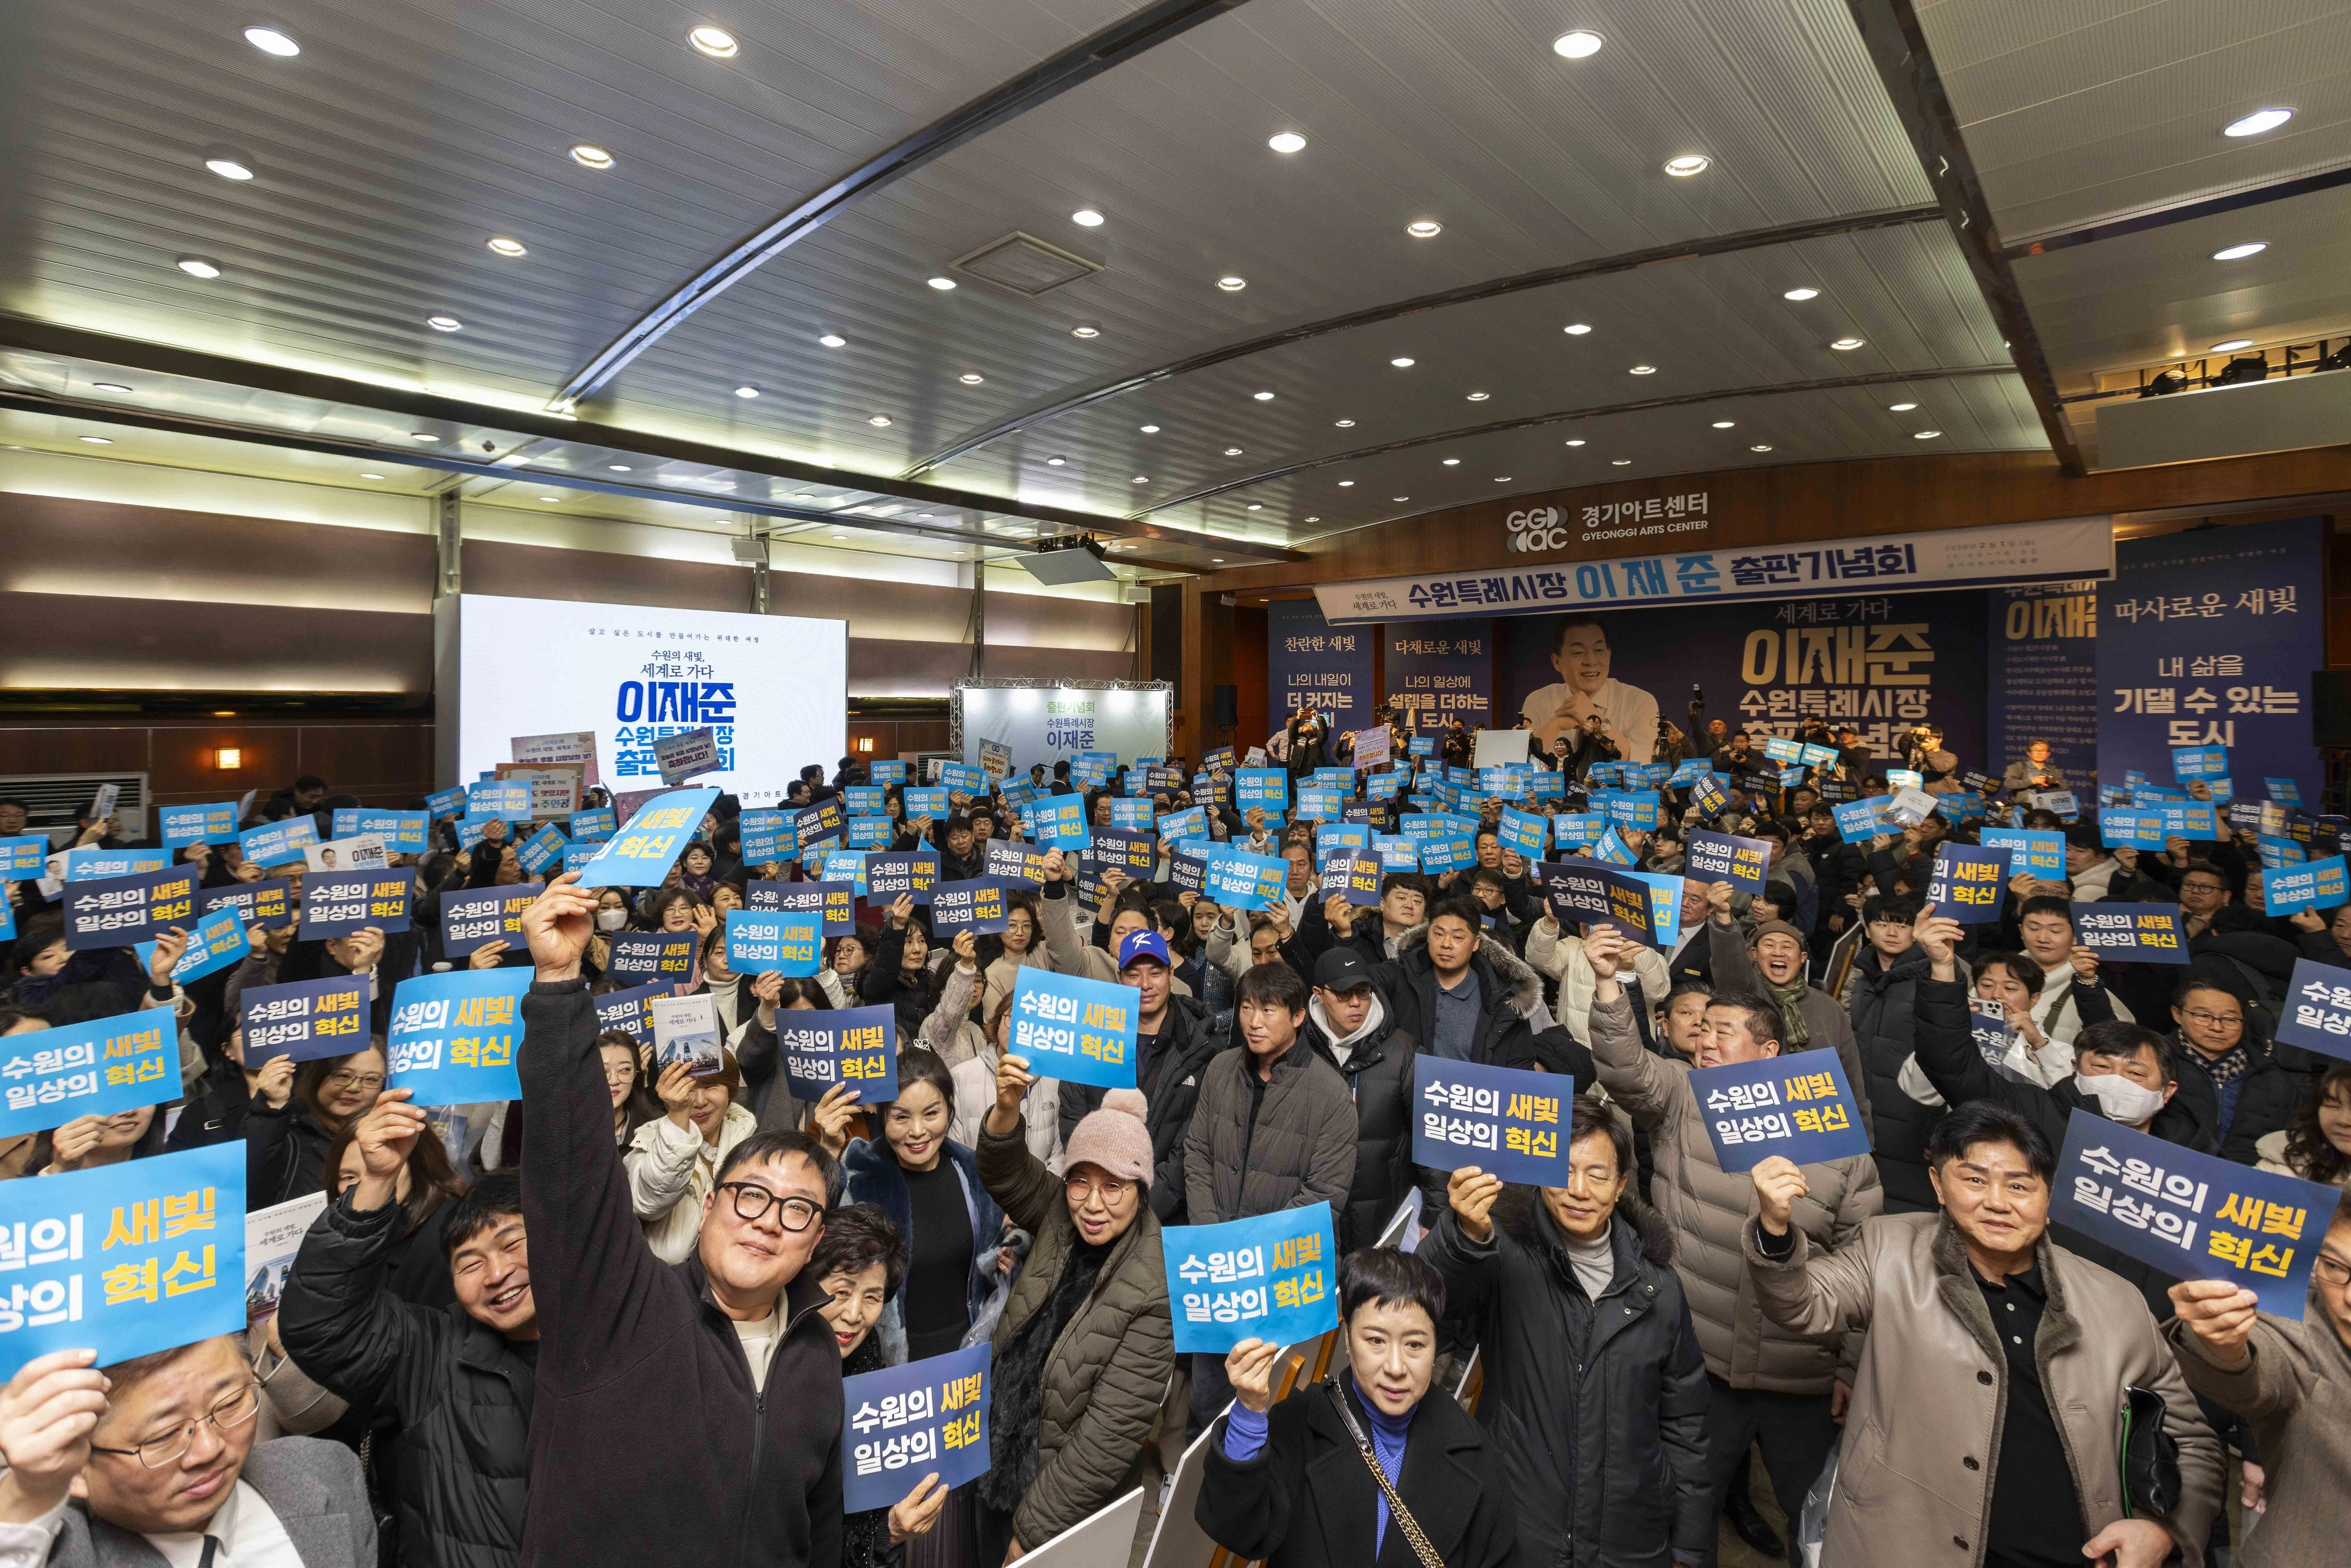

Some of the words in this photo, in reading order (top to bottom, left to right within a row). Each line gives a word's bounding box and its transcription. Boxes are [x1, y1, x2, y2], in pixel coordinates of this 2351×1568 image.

[1582, 492, 1707, 528] 경기아트센터
[1582, 529, 1637, 541] GYEONGGI
[1639, 525, 1665, 535] ARTS
[1667, 521, 1708, 532] CENTER
[1409, 572, 1567, 609] 수원특례시장
[1576, 555, 1722, 599] 이재준
[1731, 544, 1917, 586] 출판기념회
[1353, 601, 1379, 611] 세계로
[1379, 599, 1397, 609] 가다
[1374, 591, 1389, 599] 새빛,
[2116, 592, 2228, 624] 따사로운
[2234, 585, 2299, 615] 새빛
[1774, 601, 1842, 624] 세계로
[1848, 598, 1894, 621] 가다
[669, 632, 709, 641] 만들어가는
[1284, 636, 1325, 652] 찬란한
[1327, 635, 1356, 652] 새빛
[1395, 640, 1450, 655] 다채로운
[1454, 639, 1481, 655] 새빛
[651, 651, 680, 662] 수원의
[684, 651, 705, 662] 새빛,
[1741, 623, 1935, 685] 이재준
[2158, 658, 2184, 677] 내
[2189, 655, 2244, 677] 삶을
[641, 663, 684, 678] 세계로
[686, 664, 714, 679] 가다
[1288, 674, 1311, 686] 나의
[1315, 674, 1351, 686] 내일이
[1405, 676, 1430, 688] 나의
[1434, 676, 1471, 688] 일상에
[617, 681, 736, 723] 이재준
[1046, 701, 1095, 713] 출판기념회
[1287, 692, 1302, 709] 더
[1306, 692, 1353, 709] 커지는
[1388, 694, 1436, 709] 설렘을
[1440, 693, 1488, 709] 더하는
[1740, 689, 1932, 718] 수원특례시장
[2114, 687, 2176, 715] 기댈
[2183, 688, 2218, 713] 수
[2228, 686, 2299, 713] 있는
[1047, 718, 1095, 728] 수원특례시장
[2167, 721, 2235, 747] 도시
[1047, 730, 1095, 749] 이재준
[615, 747, 735, 776] 출판회
[668, 751, 709, 768] 축하합니다!
[540, 799, 570, 809] 주인공
[1036, 809, 1056, 823] 수원의
[1059, 806, 1079, 819] 새빛
[1038, 825, 1057, 839] 일상의
[1059, 822, 1082, 836] 혁신
[1325, 859, 1350, 873] 수원의
[1353, 860, 1377, 875] 새빛
[74, 888, 145, 911] 수원의
[151, 879, 190, 901] 새빛
[1322, 875, 1349, 888] 일상의
[1352, 877, 1376, 892] 혁신
[75, 909, 146, 932] 일상의
[152, 900, 190, 920] 혁신
[2079, 914, 2132, 929] 수원의
[2137, 916, 2173, 930] 새빛
[2082, 932, 2136, 946] 일상의
[2139, 933, 2178, 948] 혁신
[248, 997, 309, 1023] 수원의
[314, 991, 359, 1013] 새빛
[393, 1000, 450, 1036] 수원의
[454, 996, 514, 1026] 새빛
[1020, 990, 1078, 1023] 수원의
[1083, 1003, 1126, 1032] 새빛
[249, 1021, 309, 1047] 일상의
[315, 1014, 359, 1036] 혁신
[784, 1029, 833, 1052] 수원의
[840, 1026, 883, 1050] 새빛
[1016, 1021, 1074, 1055] 일상의
[1081, 1034, 1123, 1064] 혁신
[2, 1043, 94, 1080] 수원의
[104, 1029, 161, 1058] 새빛
[390, 1039, 443, 1073] 일상의
[451, 1036, 511, 1067] 혁신
[788, 1057, 835, 1081] 일상의
[840, 1055, 886, 1079] 혁신
[6, 1071, 98, 1110] 일상의
[106, 1057, 165, 1085] 혁신
[1707, 1081, 1780, 1113] 수원의
[1785, 1072, 1838, 1101] 새빛
[1425, 1080, 1499, 1116] 수원의
[1506, 1094, 1558, 1124] 새빛
[1424, 1113, 1498, 1150] 일상의
[1505, 1127, 1556, 1157] 혁신
[1716, 1113, 1792, 1144] 일상의
[1793, 1104, 1850, 1133] 혁신
[2080, 1147, 2208, 1214] 수원의
[2216, 1193, 2306, 1239] 새빛
[0, 1213, 83, 1271] 원의
[103, 1187, 215, 1249] 새빛
[286, 1227, 304, 1238] 가다
[2074, 1176, 2197, 1250] 일상의
[2209, 1231, 2294, 1277] 혁신
[1180, 1246, 1264, 1284] 수원의
[1272, 1233, 1321, 1271] 새빛
[0, 1274, 82, 1332] 상의
[103, 1245, 215, 1304] 혁신
[1183, 1286, 1268, 1322] 일상의
[1274, 1270, 1324, 1307] 혁신
[853, 1387, 933, 1433] 수원의
[941, 1372, 982, 1412] 새빛
[855, 1428, 936, 1475] 일상의
[942, 1410, 980, 1449] 혁신
